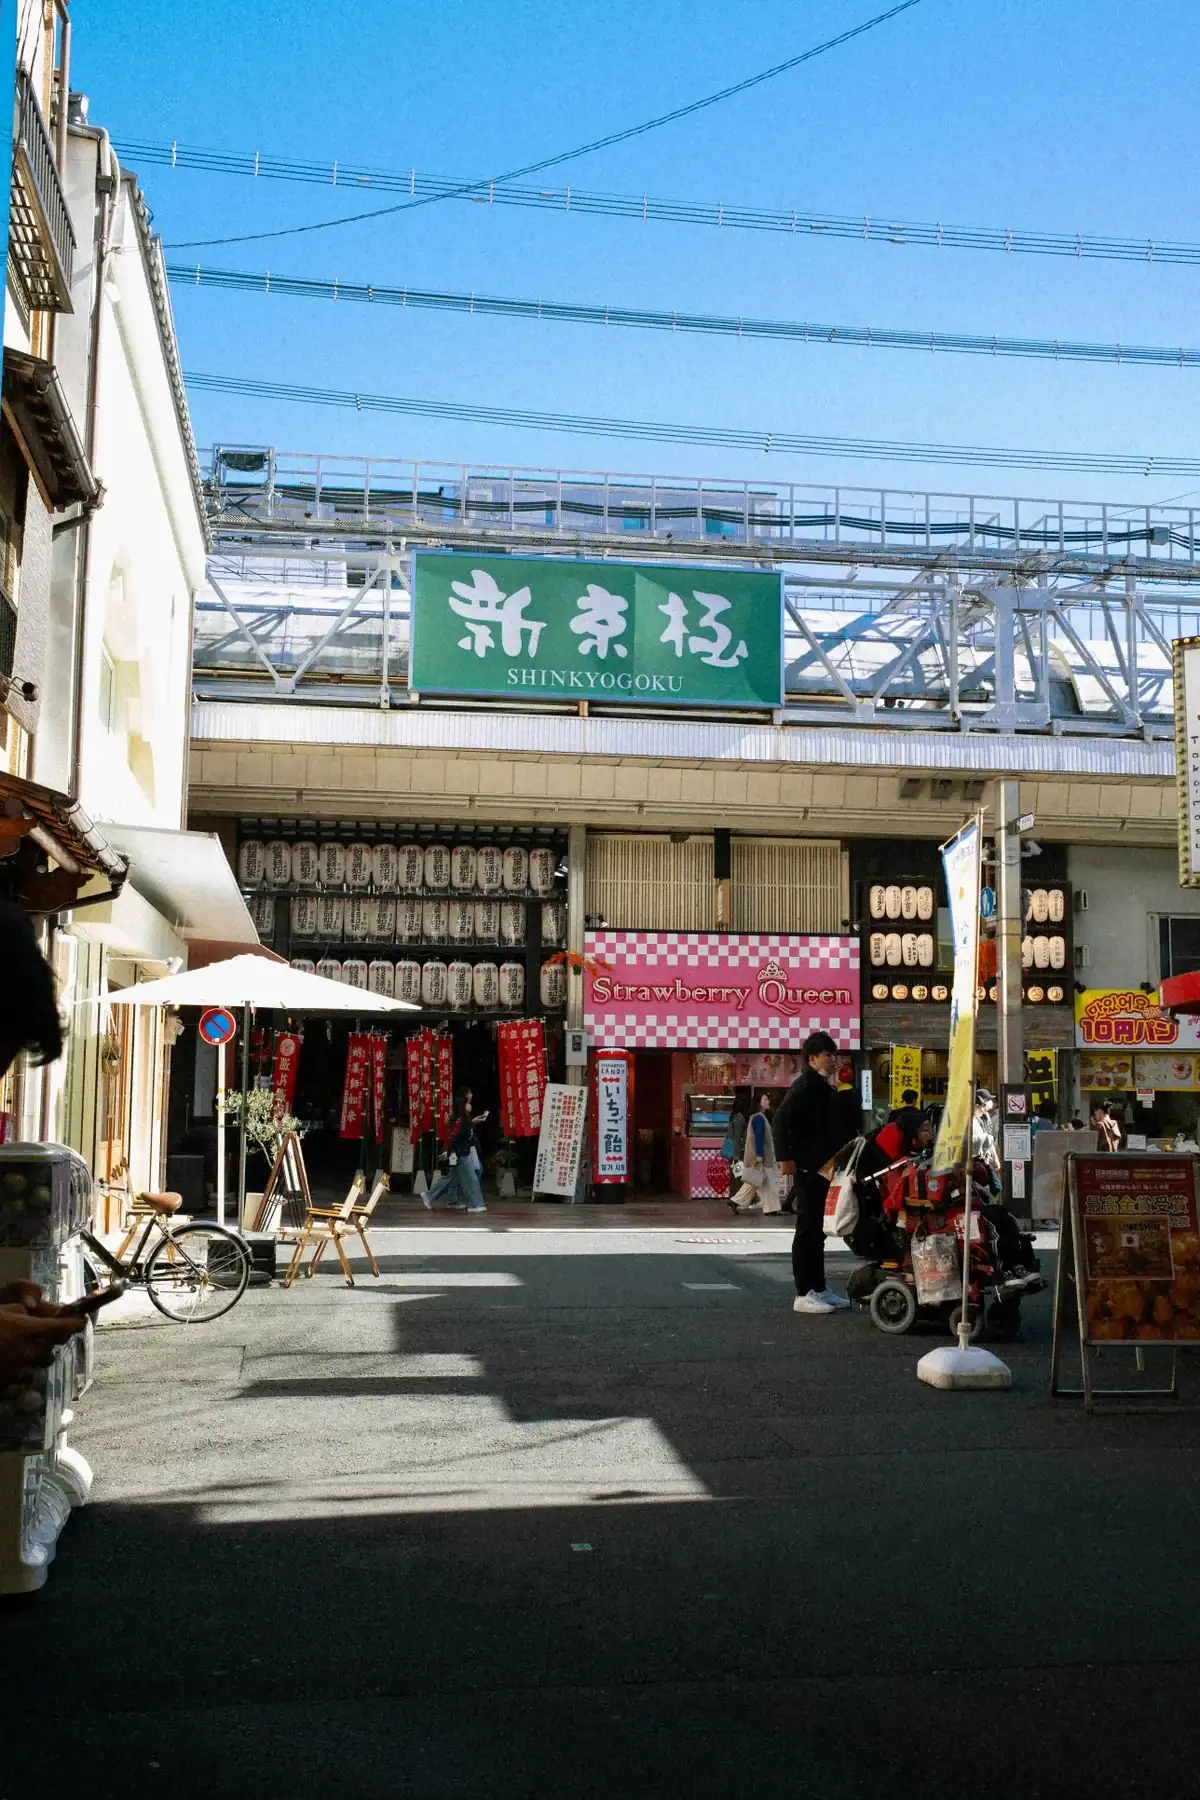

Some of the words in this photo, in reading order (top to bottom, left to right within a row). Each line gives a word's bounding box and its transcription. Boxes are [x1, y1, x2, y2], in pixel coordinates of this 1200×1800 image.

[448, 569, 748, 668] 新京極
[507, 668, 683, 692] SHINKYOGOKU
[593, 976, 750, 1010] Strawberry
[759, 979, 851, 1015] Queen
[1085, 992, 1150, 1018] 맛있어요
[1080, 1017, 1178, 1044] 10円パン
[603, 1085, 624, 1154] いちご飴
